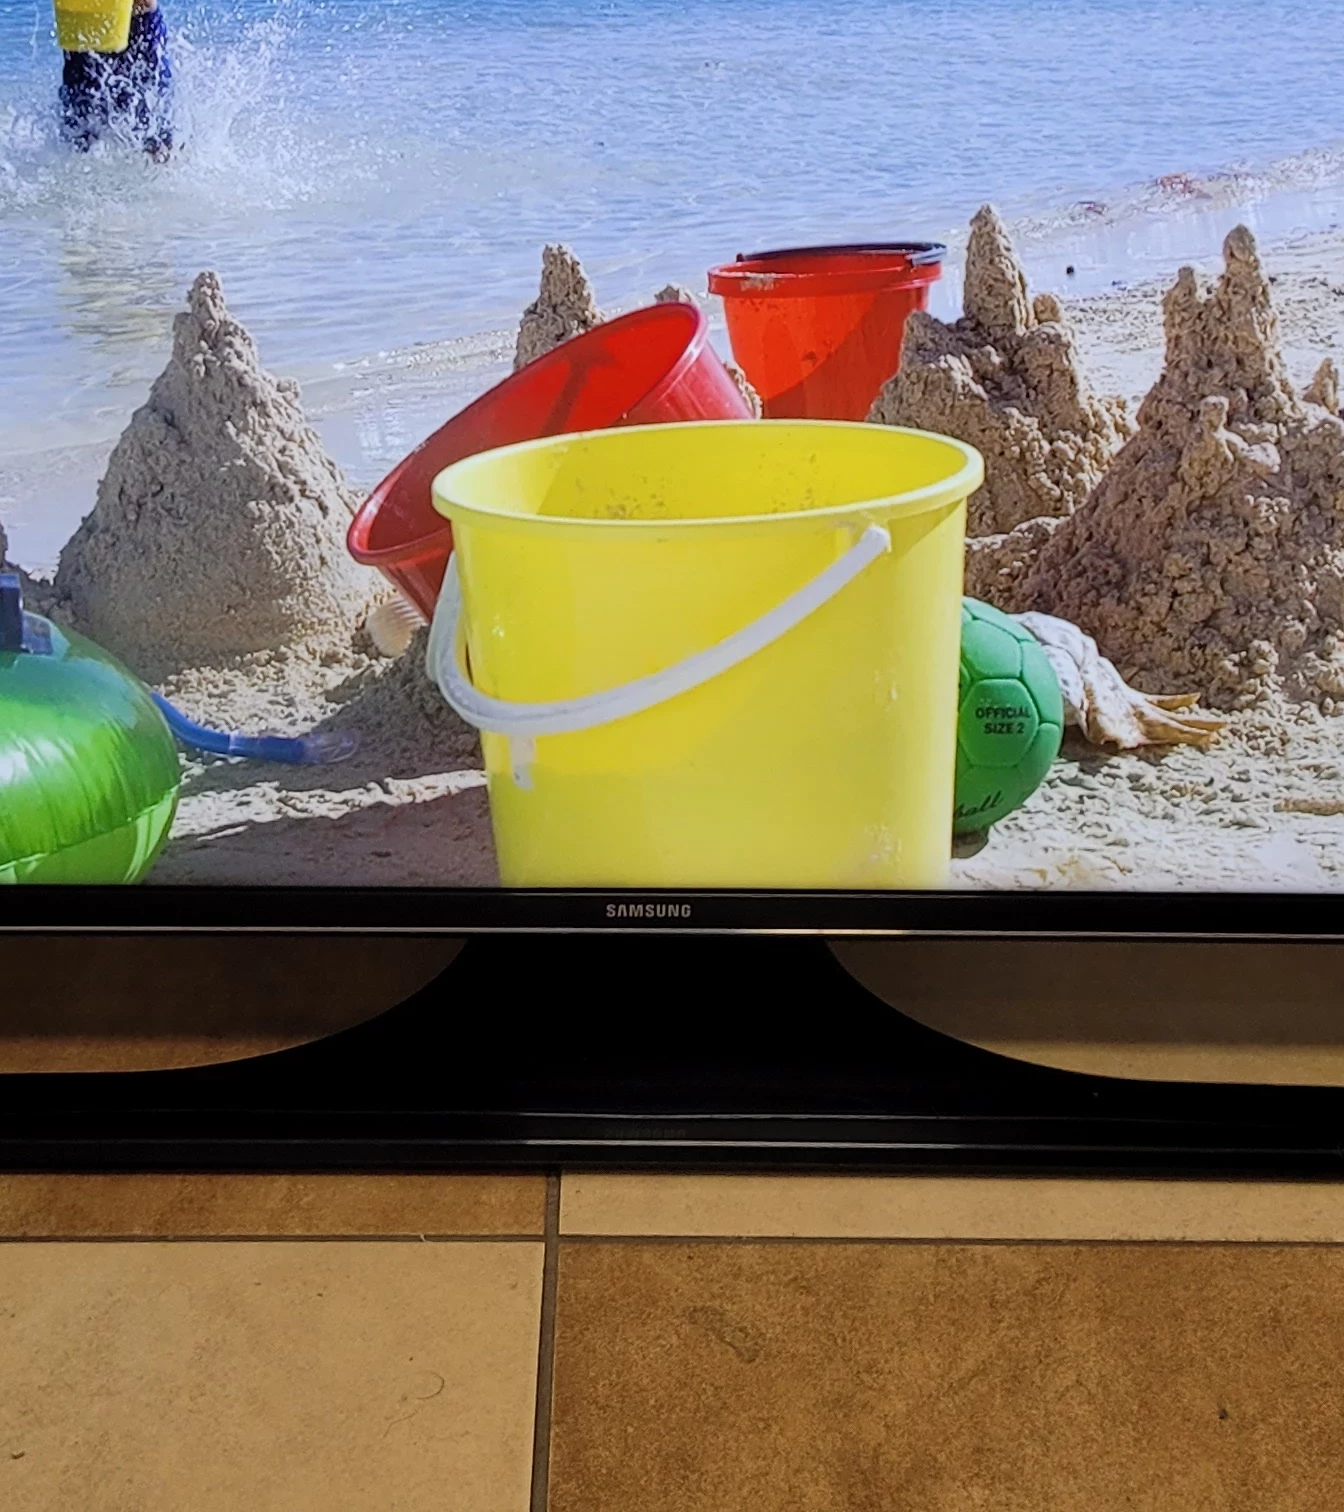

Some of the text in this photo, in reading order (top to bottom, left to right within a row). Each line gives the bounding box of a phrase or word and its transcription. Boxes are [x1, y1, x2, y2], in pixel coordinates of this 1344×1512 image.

[974, 705, 1032, 720] OFFICIAL
[984, 721, 1025, 735] SIZE 2
[606, 903, 692, 918] SAMSUNG
